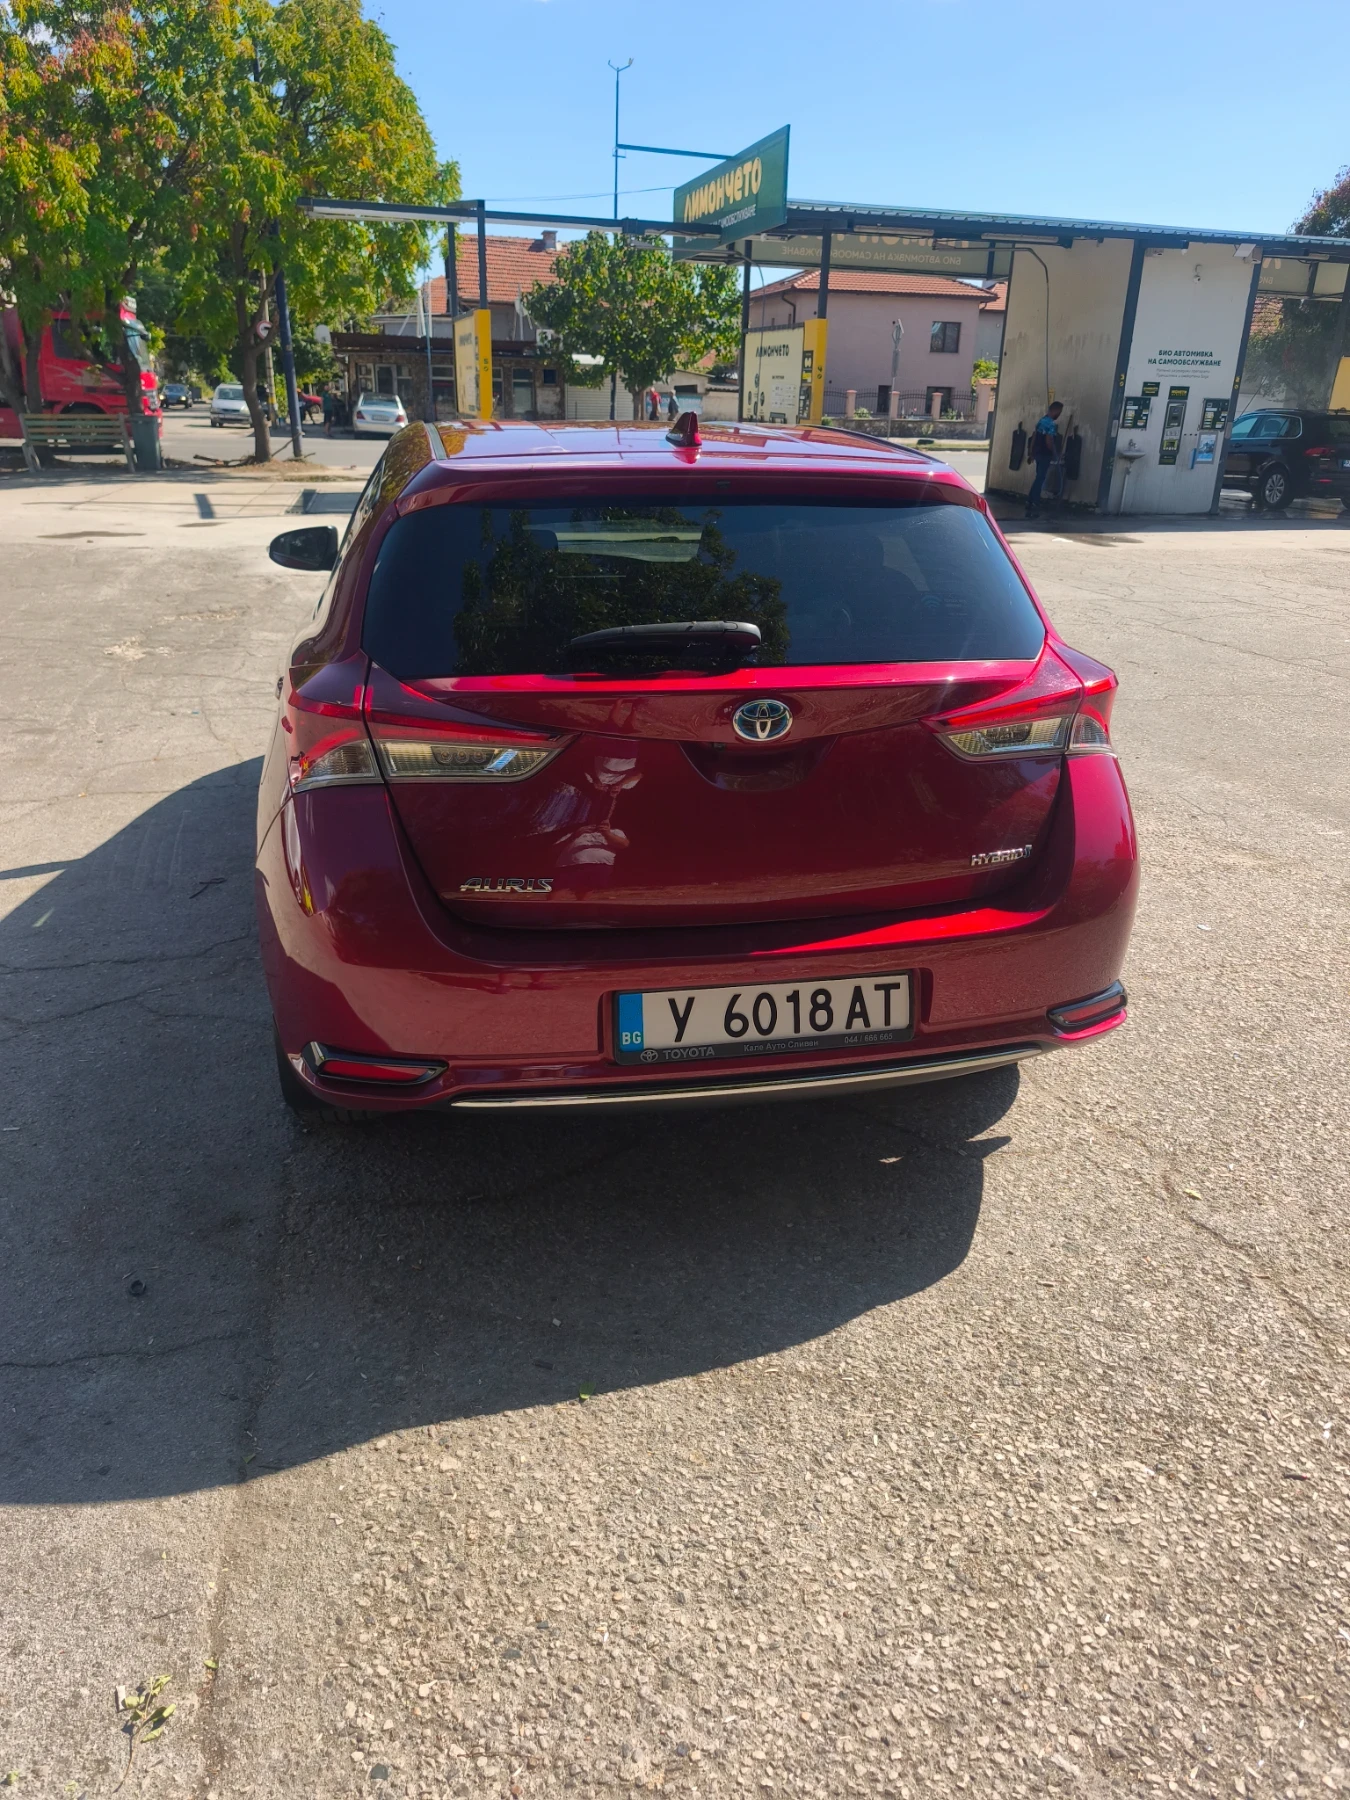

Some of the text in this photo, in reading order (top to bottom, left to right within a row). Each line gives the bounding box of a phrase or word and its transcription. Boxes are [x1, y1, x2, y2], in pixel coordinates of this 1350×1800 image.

[1158, 358, 1222, 367] САМООБСЛУЖВАНЕ
[971, 848, 1024, 866] HYBRID
[460, 878, 554, 892] AURIS
[724, 988, 834, 1038] 6018
[622, 1031, 642, 1046] BG
[663, 1046, 716, 1060] TOYOTA
[766, 1043, 786, 1051] Ауто
